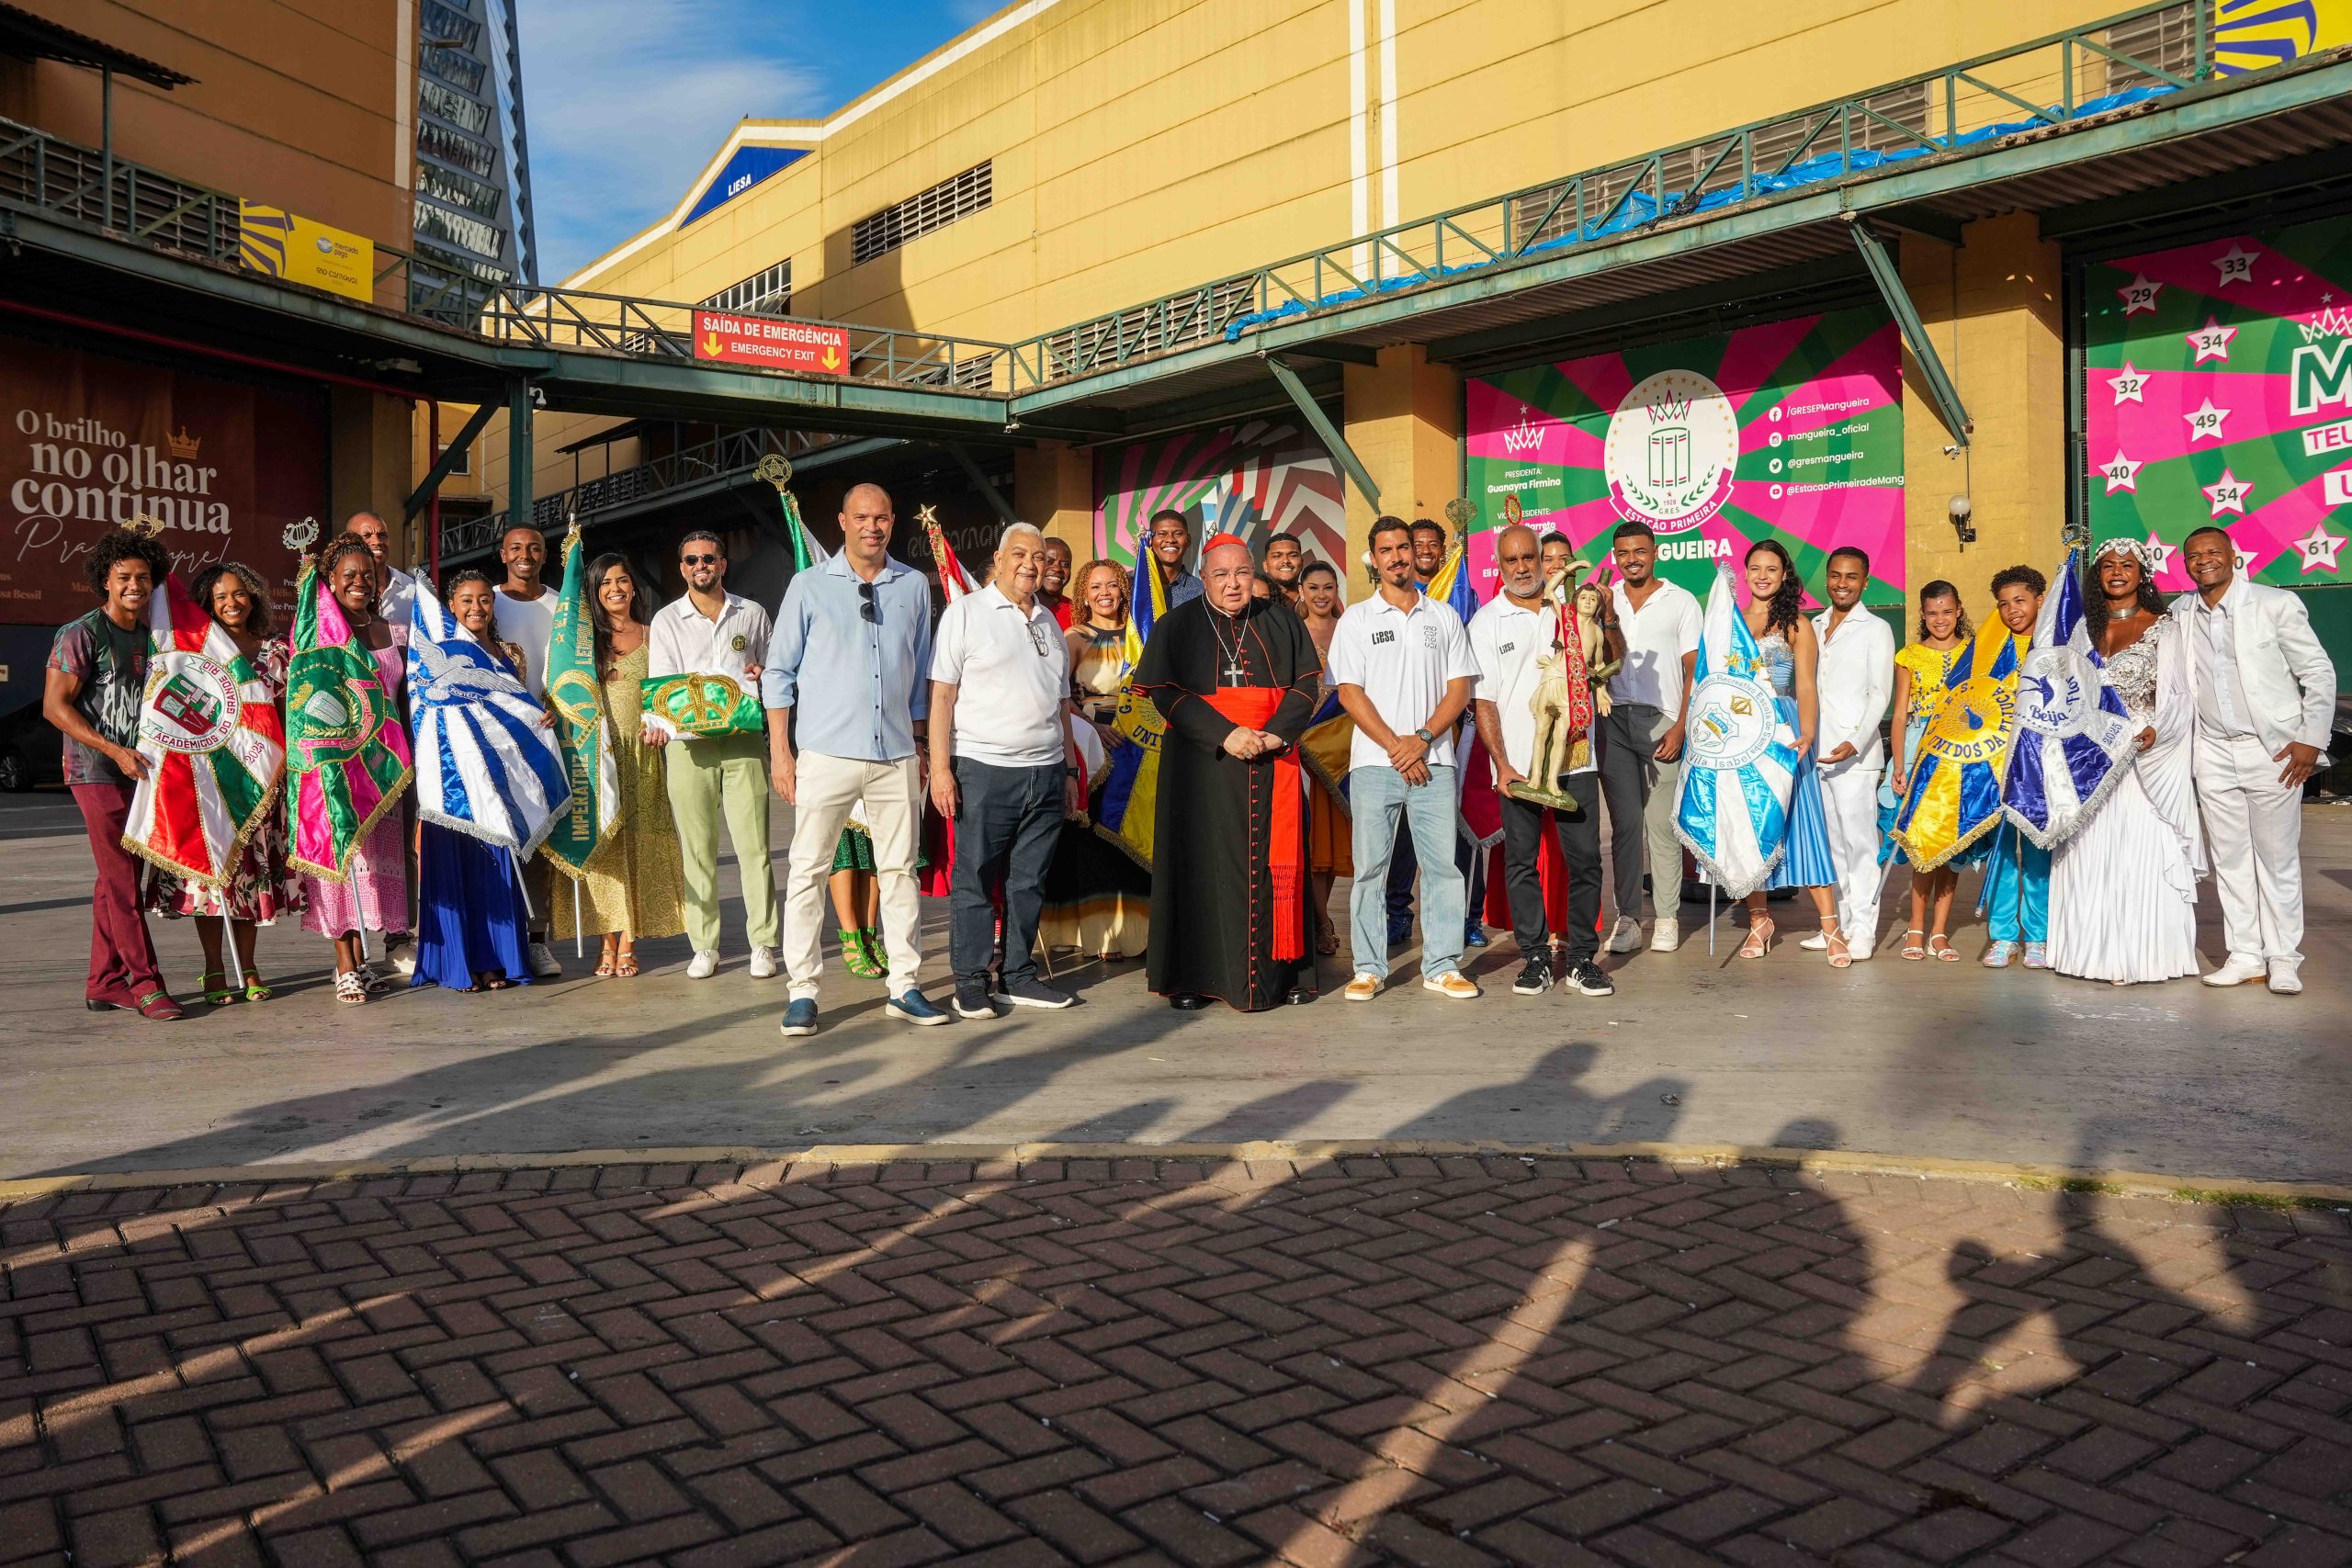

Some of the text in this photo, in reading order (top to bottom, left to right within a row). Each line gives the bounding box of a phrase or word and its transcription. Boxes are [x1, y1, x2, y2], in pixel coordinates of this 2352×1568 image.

[728, 173, 752, 197] LIESA
[334, 243, 359, 255] mercado
[334, 249, 348, 259] pago
[2224, 257, 2247, 274] 33
[2131, 288, 2152, 304] 29
[703, 317, 842, 346] SAÍDA DE EMERGÊNCIA
[2200, 333, 2223, 351] 34
[730, 342, 815, 362] EMERGENCY EXIT
[2119, 378, 2139, 394] 32
[17, 410, 127, 448] O brilho
[2195, 412, 2218, 429] 49
[1787, 423, 1870, 442] mangueira_oficial
[29, 441, 218, 495] no olhar
[1787, 450, 1864, 469] @gresmangueira
[1505, 467, 1543, 479] PRESIDENTA:
[2109, 465, 2130, 479] 40
[1487, 478, 1561, 494] Guanayra Firmino
[2216, 487, 2239, 503] 54
[11, 478, 232, 535] continua
[1658, 506, 1680, 515] GRES
[1670, 501, 1717, 530] PRIMEIRA
[2308, 540, 2330, 556] 61
[153, 660, 236, 749] ACADÊMICOS DO GRANDE RIO
[1756, 692, 1771, 717] Escola
[1765, 721, 1773, 731] de
[1927, 686, 2015, 759] UNIDOS DA TIJUCA
[1750, 731, 1771, 754] Samba
[2102, 722, 2123, 746] 2025
[244, 739, 266, 764] 2025
[1690, 751, 1752, 768] Vila Isabel
[571, 753, 590, 841] IMPERATRIZ
